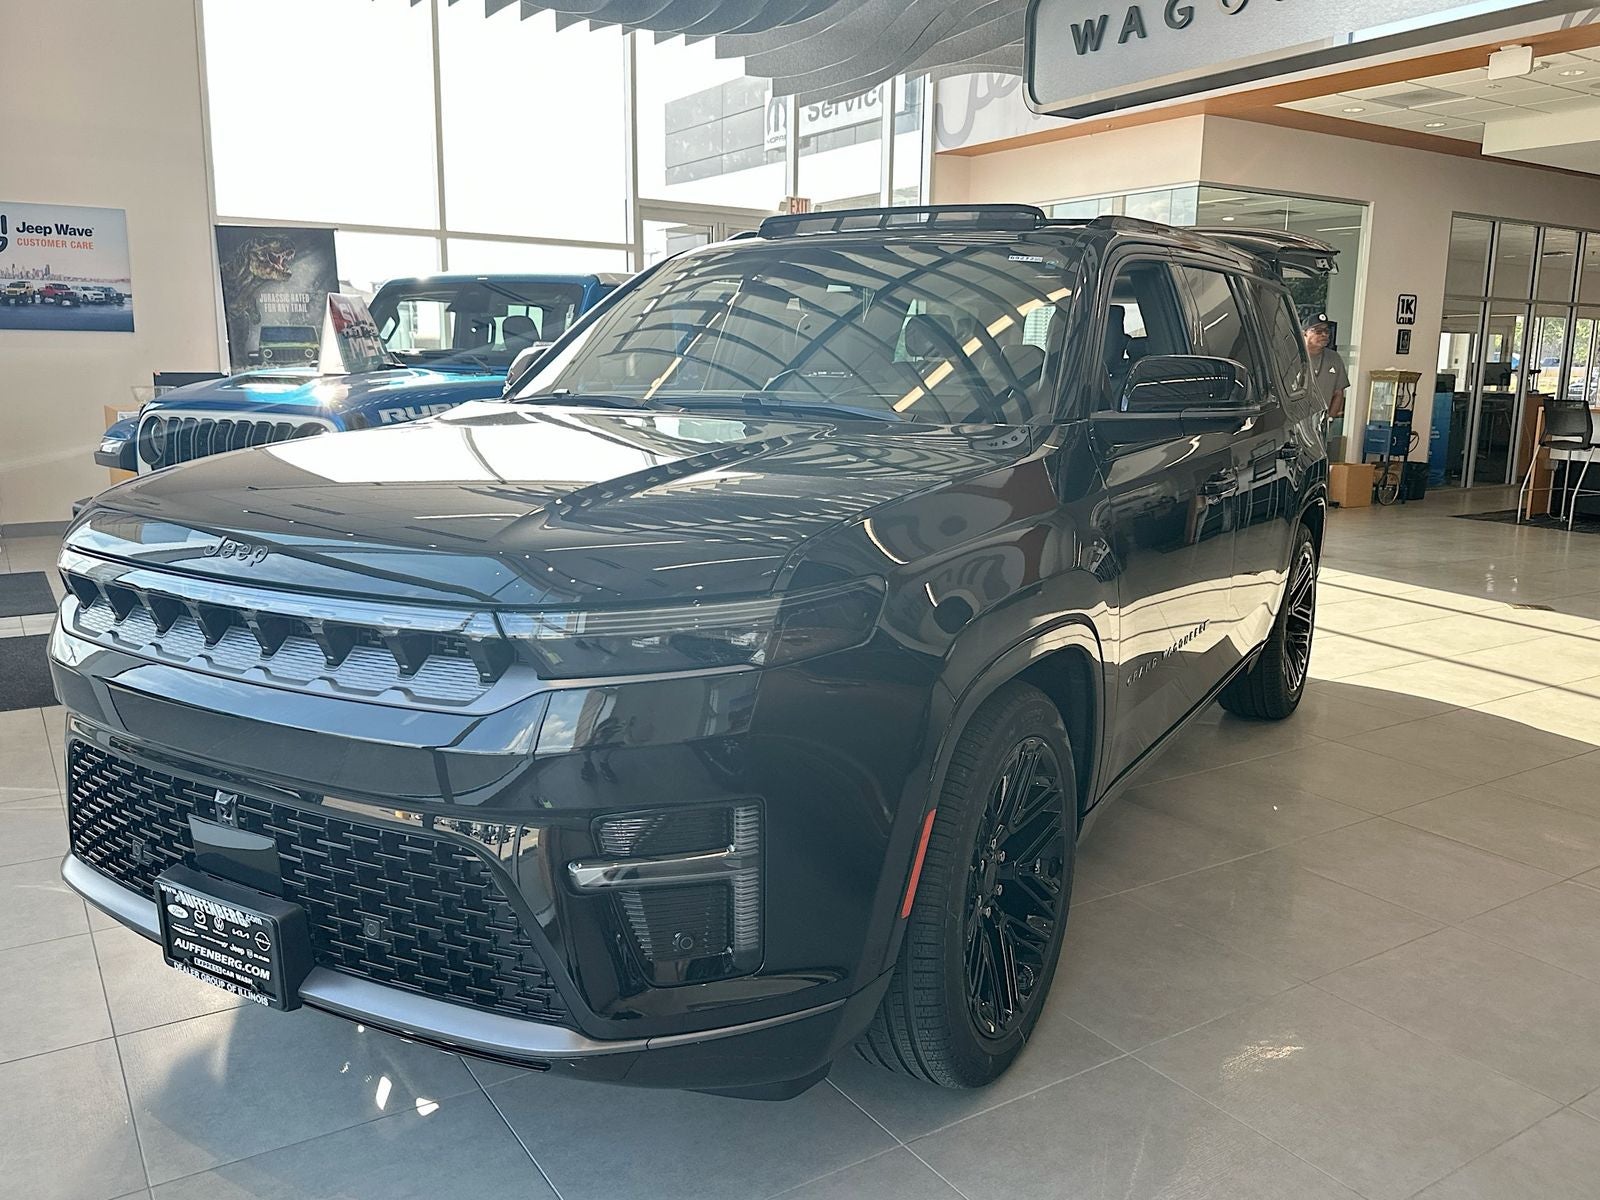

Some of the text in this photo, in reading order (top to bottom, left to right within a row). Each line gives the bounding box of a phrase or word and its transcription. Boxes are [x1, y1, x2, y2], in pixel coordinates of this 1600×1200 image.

[791, 198, 809, 215] EXIT
[16, 222, 93, 237] Jeep Wave
[16, 237, 94, 250] CUSTOMER CARE
[291, 293, 310, 303] RATED
[264, 304, 278, 313] FOR
[291, 304, 308, 313] TRAIL
[1401, 299, 1415, 315] 1K
[378, 402, 460, 424] RUB
[203, 535, 269, 568] Jeep
[174, 937, 270, 980] AUFFENBERG.COM
[200, 972, 225, 988] GROUP
[226, 983, 236, 993] OF
[238, 987, 268, 1006] ILLINOIS
